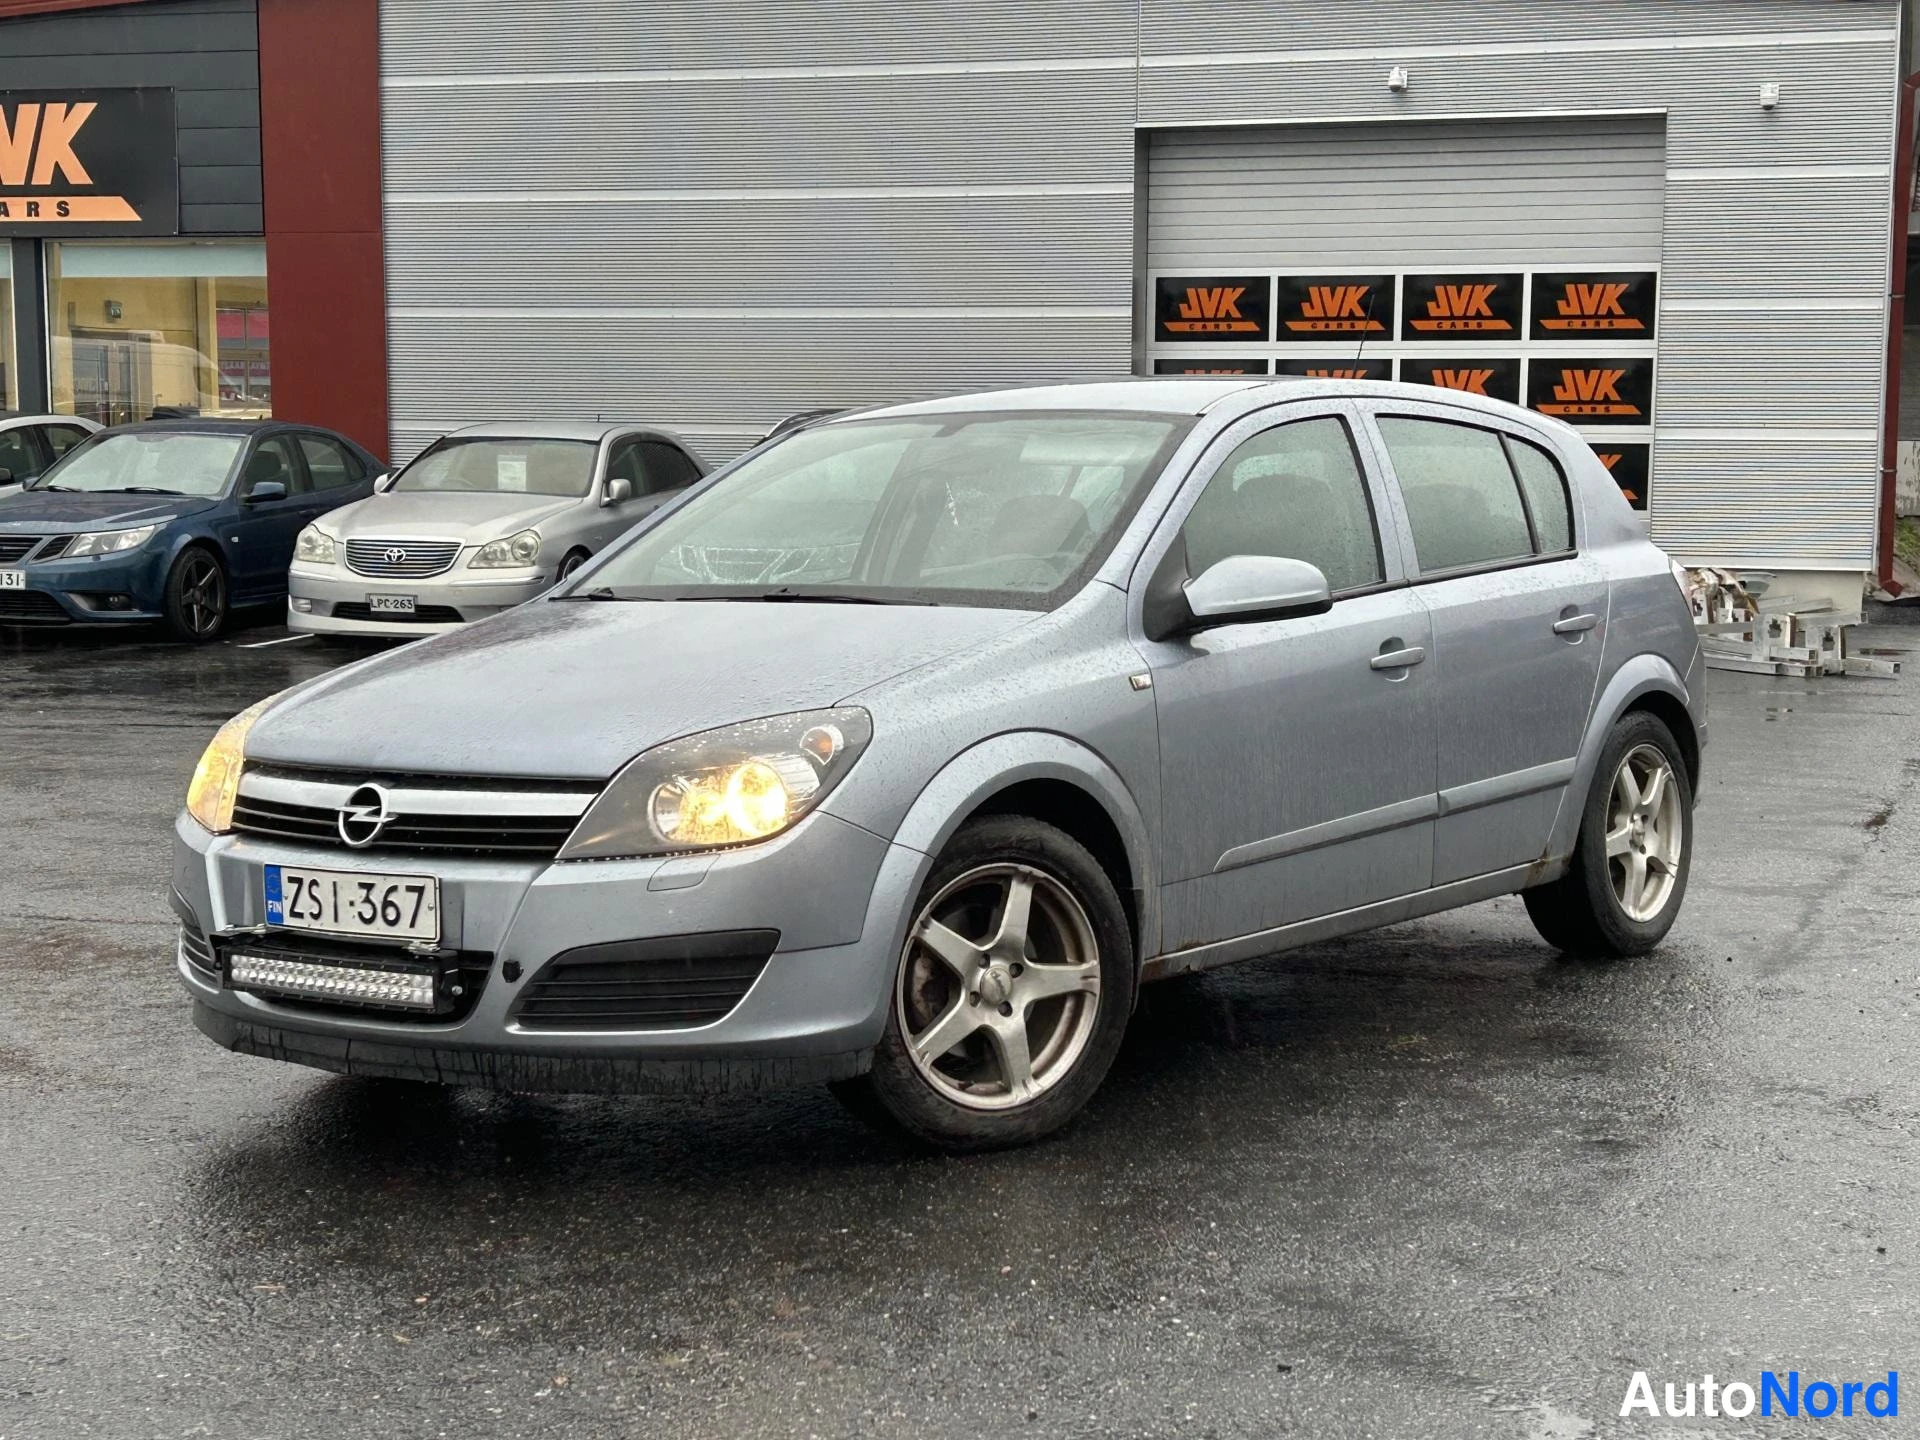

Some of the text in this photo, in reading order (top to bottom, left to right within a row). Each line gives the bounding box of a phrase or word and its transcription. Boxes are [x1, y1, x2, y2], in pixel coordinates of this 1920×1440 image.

[1178, 287, 1247, 318] JVK
[1300, 286, 1370, 317] JVK
[1426, 284, 1498, 316] JVK
[1556, 283, 1630, 315] JVK
[1310, 322, 1356, 330] CARS
[1436, 321, 1483, 329] CARS
[1566, 319, 1614, 328] CARS
[1552, 369, 1627, 401] JVK
[1562, 405, 1611, 413] CARS
[370, 598, 413, 609] LPC-263
[267, 900, 283, 913] FIN
[287, 876, 426, 929] ZSI-367
